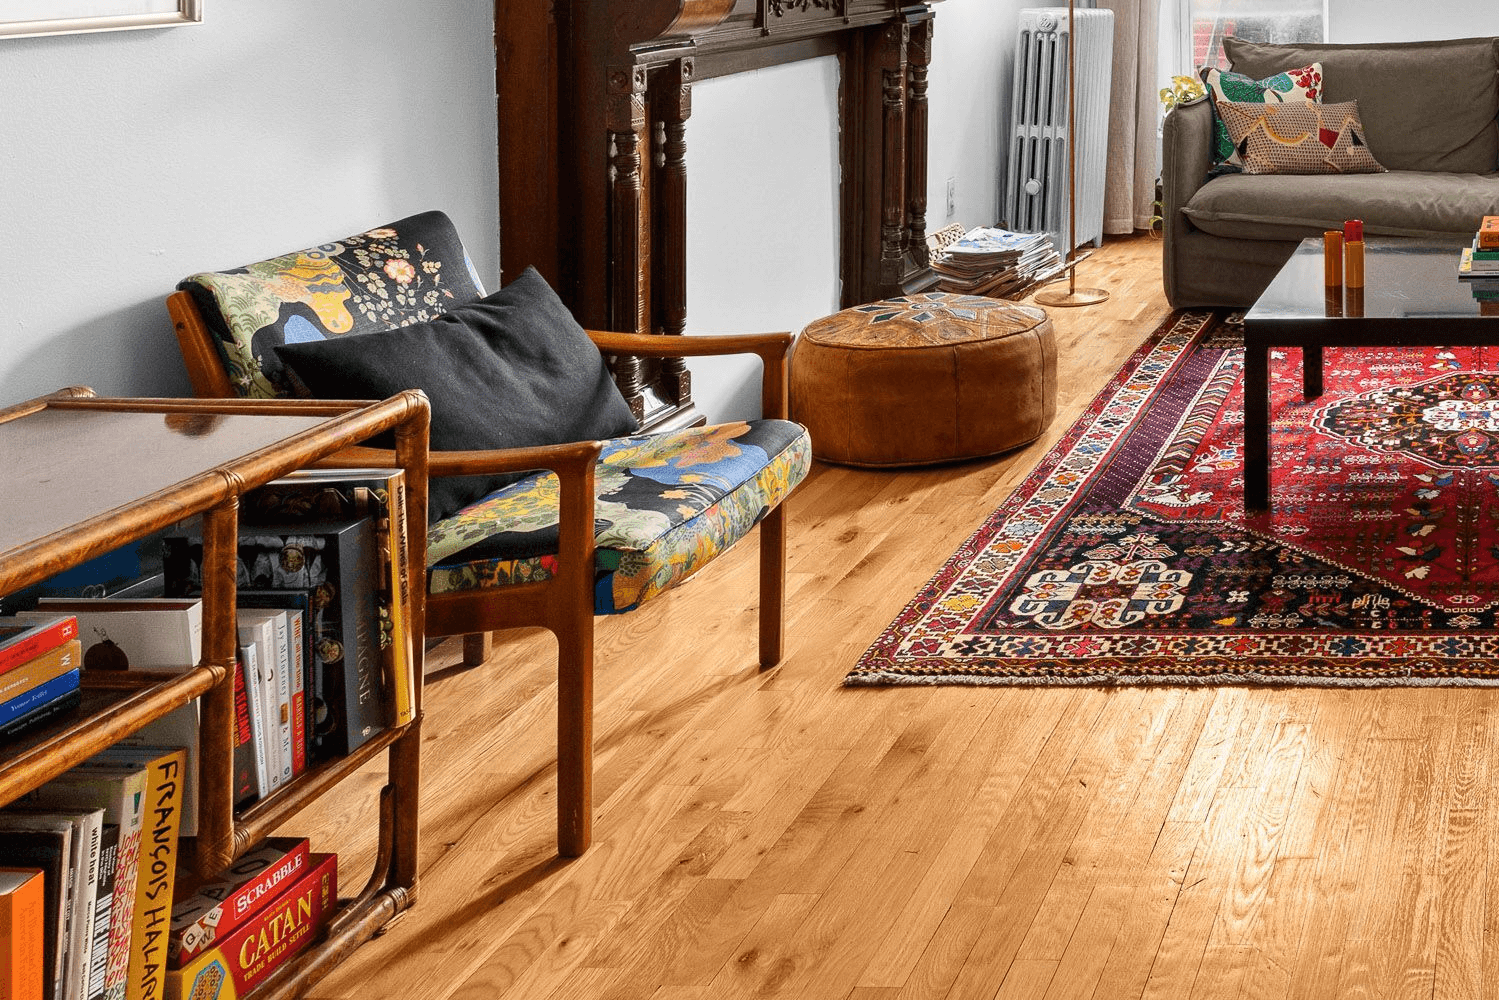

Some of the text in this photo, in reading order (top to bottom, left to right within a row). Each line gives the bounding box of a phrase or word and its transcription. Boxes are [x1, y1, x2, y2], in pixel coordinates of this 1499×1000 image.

[87, 826, 99, 886] white heat
[140, 760, 179, 1000] FRANÇOIS HALAR
[236, 853, 303, 913] SCRABBLE
[88, 893, 113, 1000] IN THE LIMELIGHT
[185, 932, 197, 946] Q
[209, 912, 218, 921] E
[239, 889, 313, 970] CATAN
[243, 923, 311, 982] TRADE BUILD SETTLE
